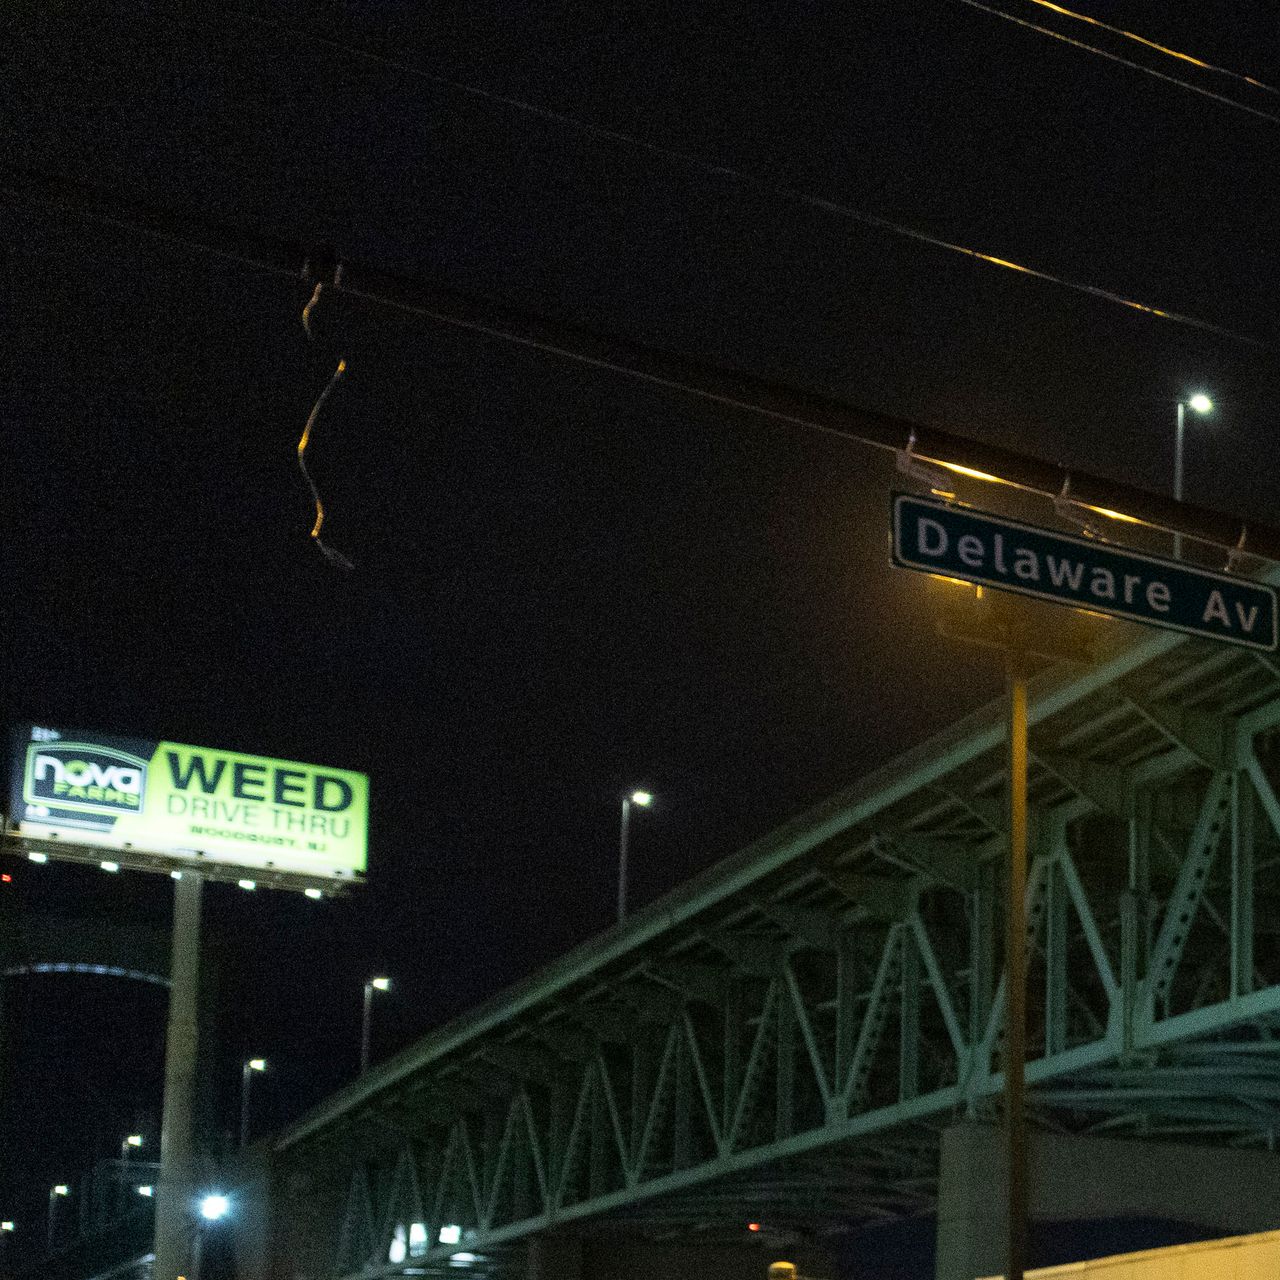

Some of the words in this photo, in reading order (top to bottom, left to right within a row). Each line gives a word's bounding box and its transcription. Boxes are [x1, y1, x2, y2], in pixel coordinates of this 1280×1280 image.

[917, 517, 1172, 612] Delaware
[1201, 589, 1259, 633] Av
[34, 754, 141, 792] nova
[54, 782, 139, 806] FARMS
[165, 751, 354, 813] WEED
[167, 794, 260, 826] DRIVE
[271, 808, 350, 839] THRU
